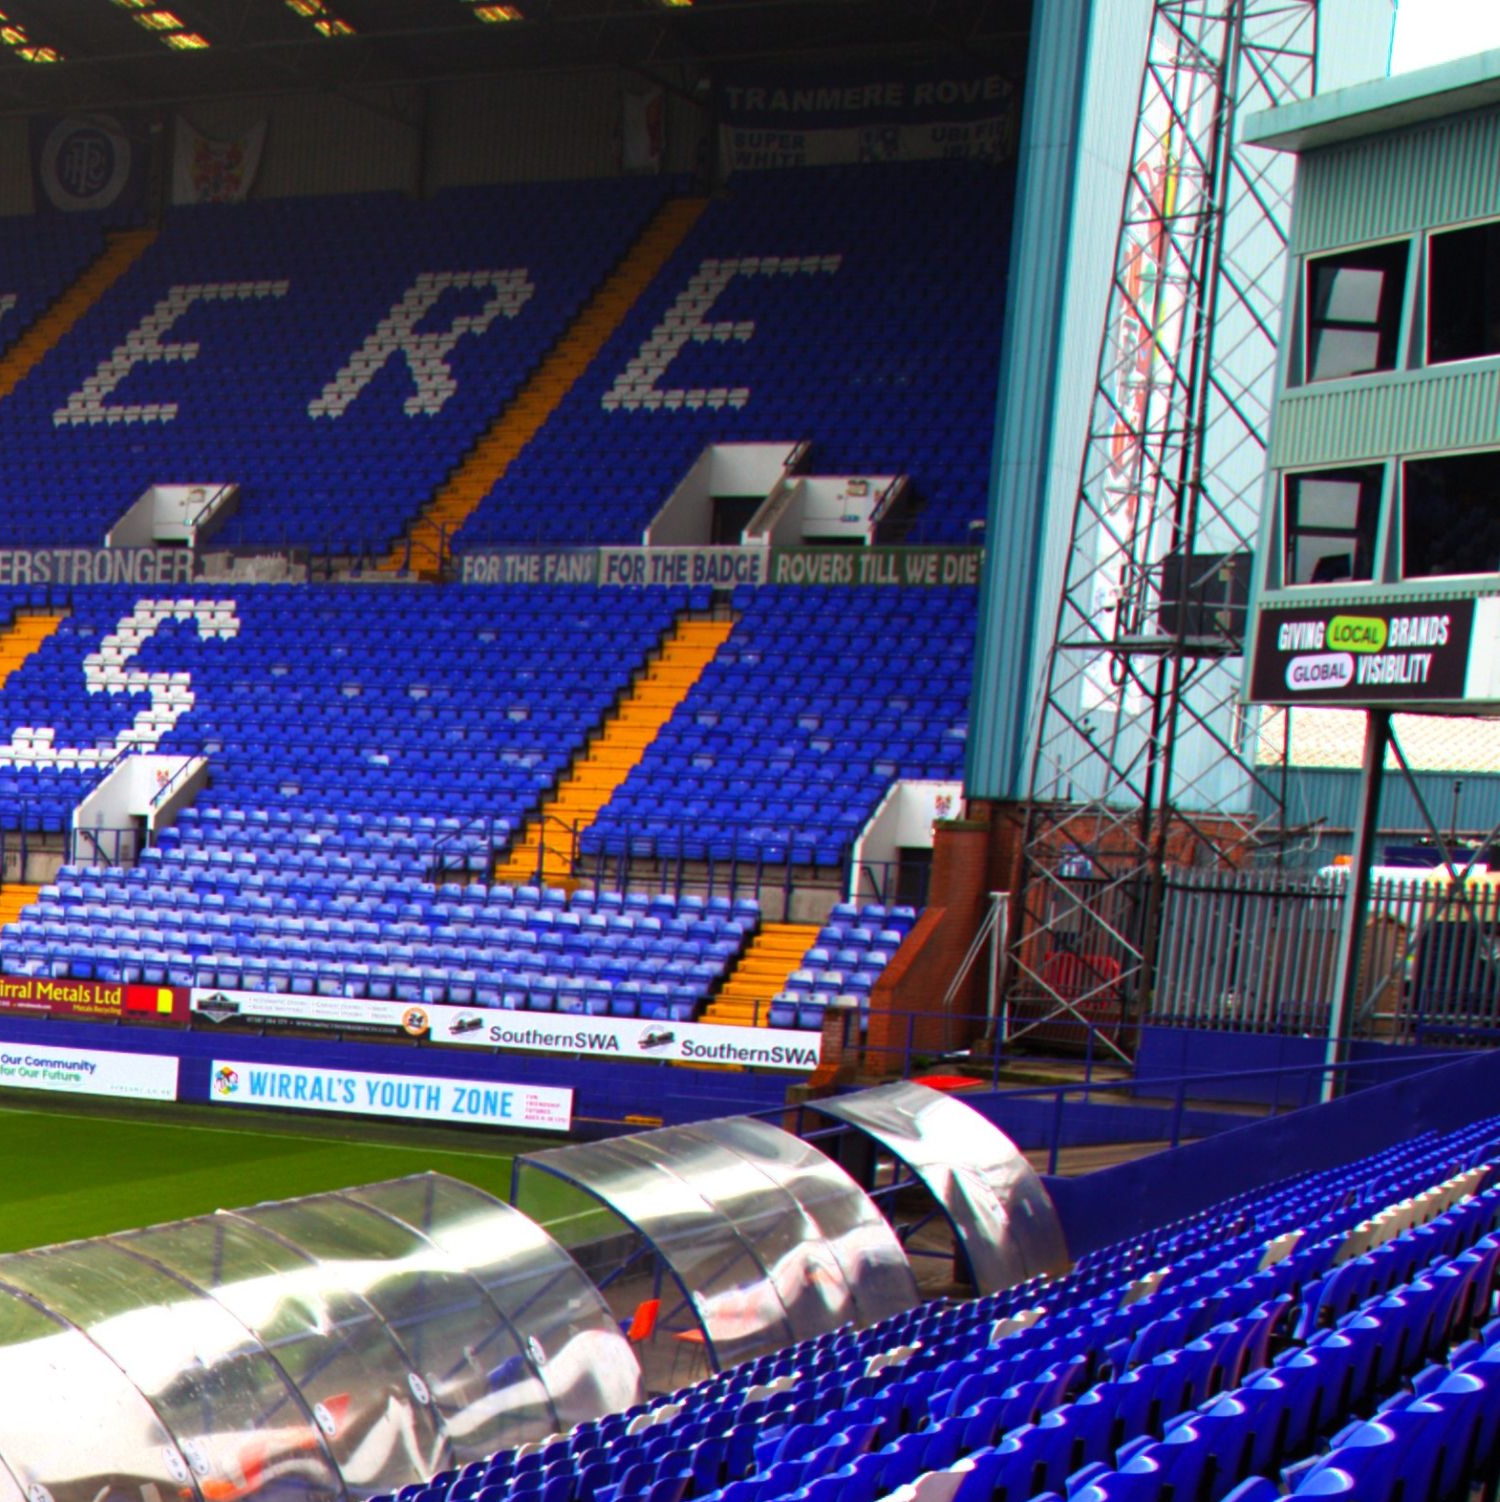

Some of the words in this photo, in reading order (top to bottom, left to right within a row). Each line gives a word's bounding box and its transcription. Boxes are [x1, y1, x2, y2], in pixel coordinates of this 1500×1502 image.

[725, 82, 904, 113] TRANMERE
[461, 556, 499, 584] FOR
[504, 556, 541, 583] THE
[544, 554, 593, 583] FANS
[606, 554, 645, 582] FOR
[650, 553, 687, 582] THE
[692, 553, 760, 582] BADGE
[776, 553, 853, 584] ROVERS
[858, 553, 898, 583] TILL
[904, 553, 941, 583] WE
[942, 552, 978, 583] DIE
[1278, 621, 1325, 650] GIVING
[1333, 624, 1380, 645] LOCAL
[1388, 615, 1449, 648] BRANDS
[1293, 661, 1346, 682] GLOBAL
[1356, 653, 1432, 684] VISIBILITY
[36, 981, 91, 1003] Metals
[95, 986, 122, 1005] Ltd
[489, 1026, 619, 1053] SouthernSWA
[681, 1039, 820, 1066] SouthernSWA
[0, 1064, 15, 1076] for
[18, 1067, 39, 1078] Our
[42, 1070, 82, 1083] Future
[1, 1053, 23, 1066] Our
[25, 1055, 97, 1076] Community
[250, 1070, 356, 1104] WIRRAL'S
[366, 1080, 441, 1111] YOUTH
[452, 1087, 514, 1118] ZONE
